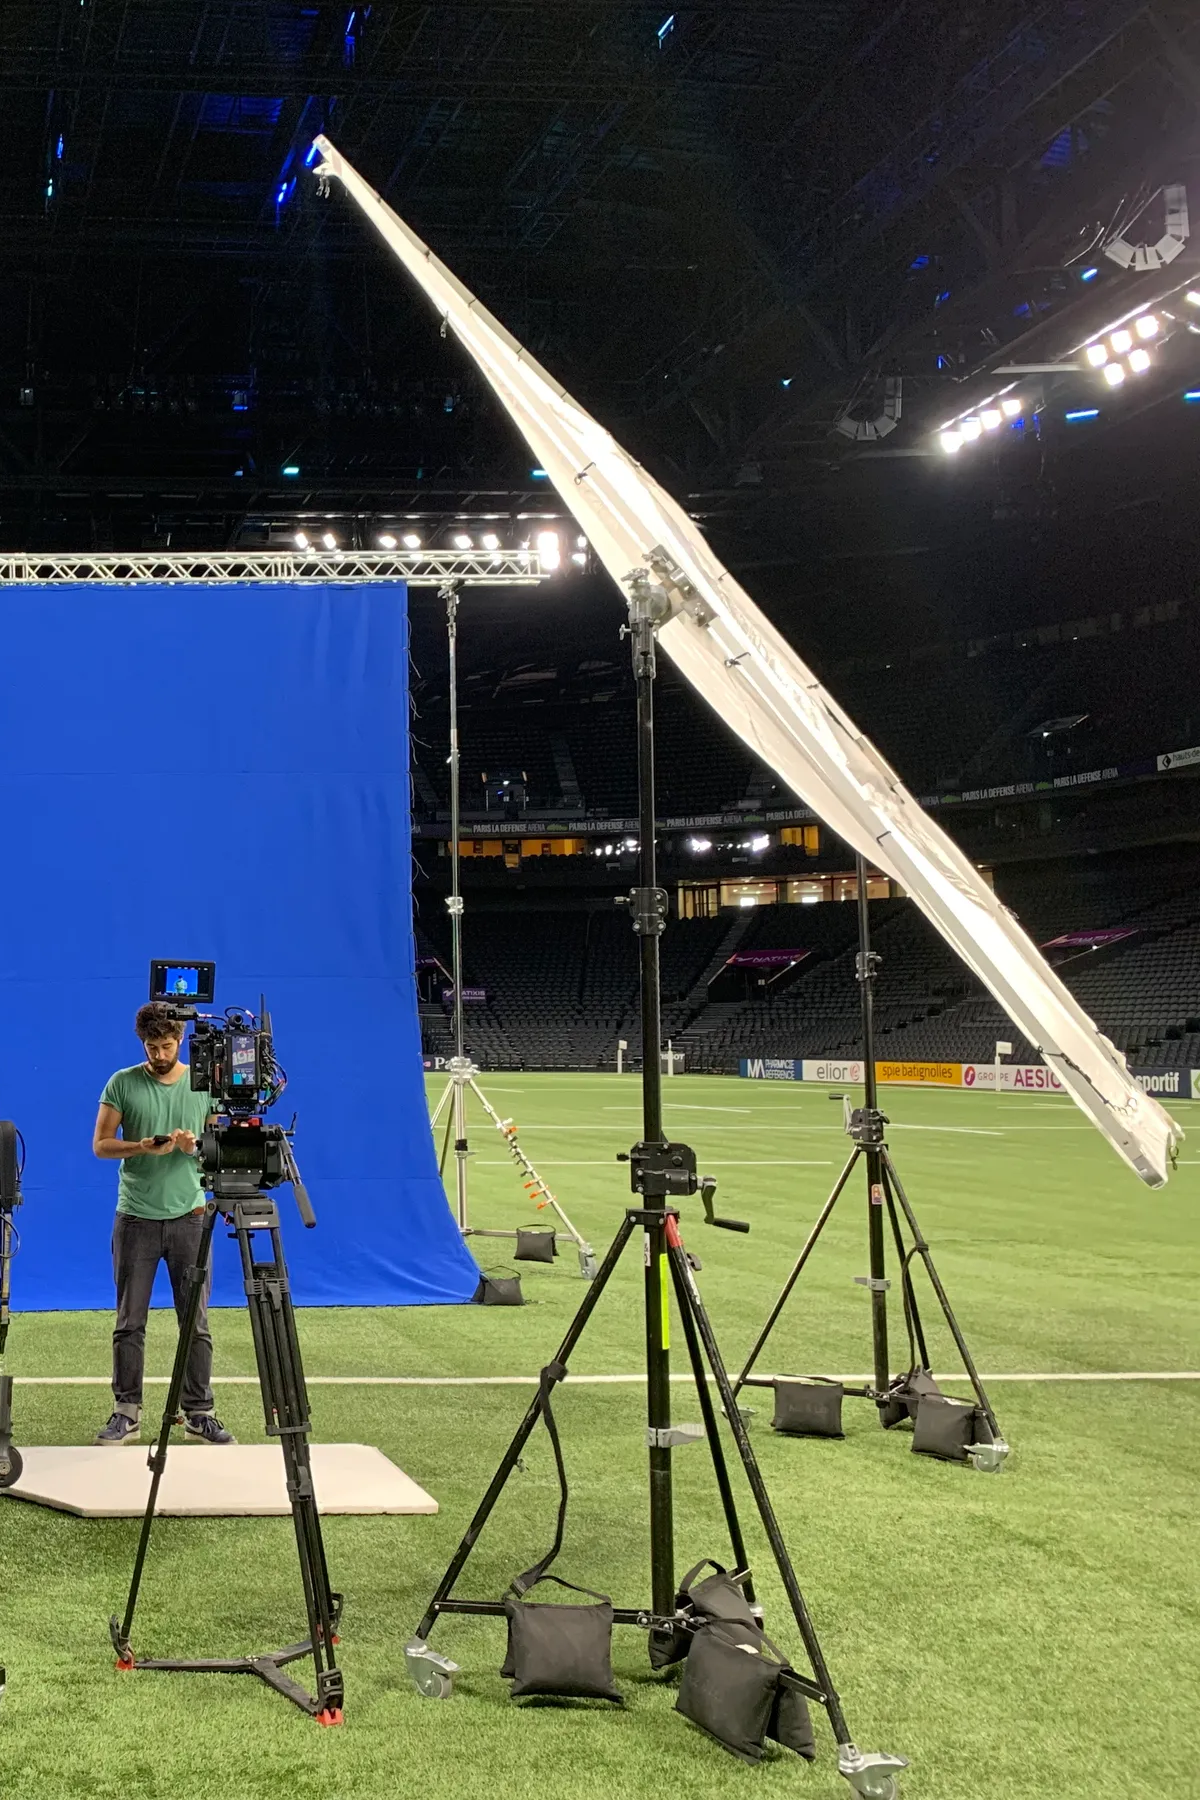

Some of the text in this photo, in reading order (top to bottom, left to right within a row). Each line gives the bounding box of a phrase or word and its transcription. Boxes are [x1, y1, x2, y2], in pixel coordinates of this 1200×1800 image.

[981, 790, 988, 799] LA
[686, 818, 694, 827] LA
[492, 824, 500, 833] LA
[816, 1064, 848, 1080] elior
[882, 1064, 952, 1080] spie batignolles
[978, 1072, 1008, 1082] GROPE
